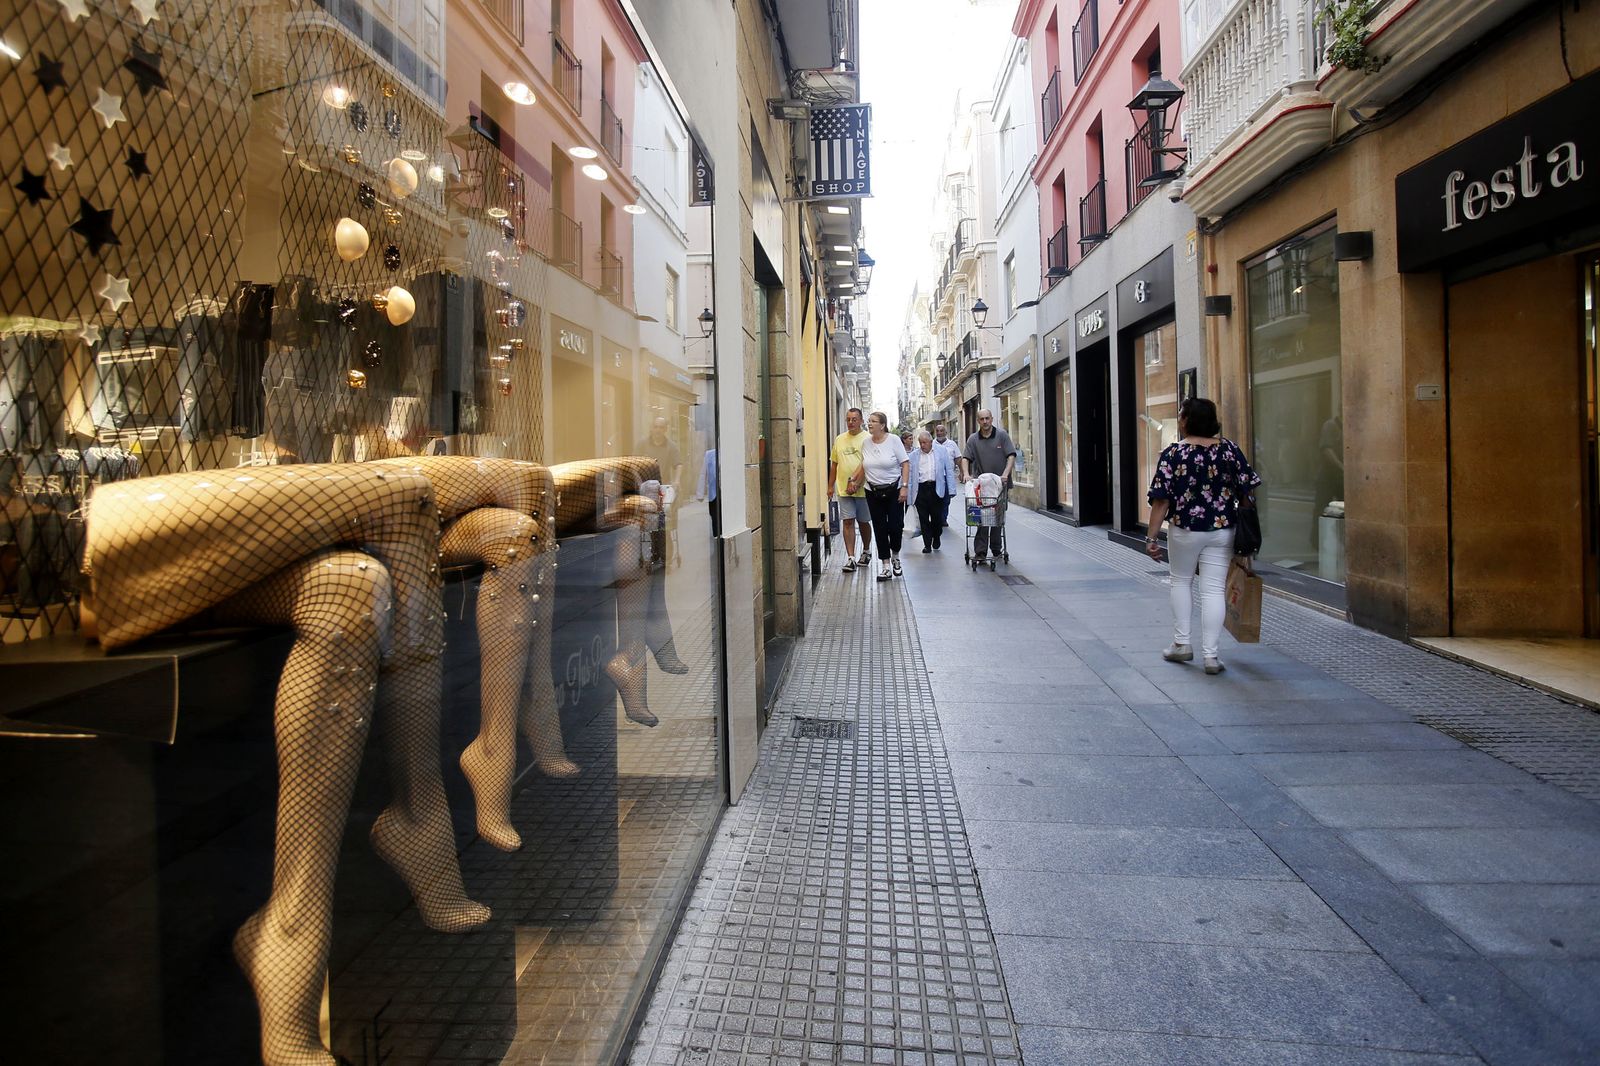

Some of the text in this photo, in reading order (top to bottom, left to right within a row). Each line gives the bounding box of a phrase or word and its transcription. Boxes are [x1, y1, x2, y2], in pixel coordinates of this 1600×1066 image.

[855, 108, 867, 180] VINTAGE
[815, 182, 866, 194] SHOP
[1441, 135, 1584, 232] festa
